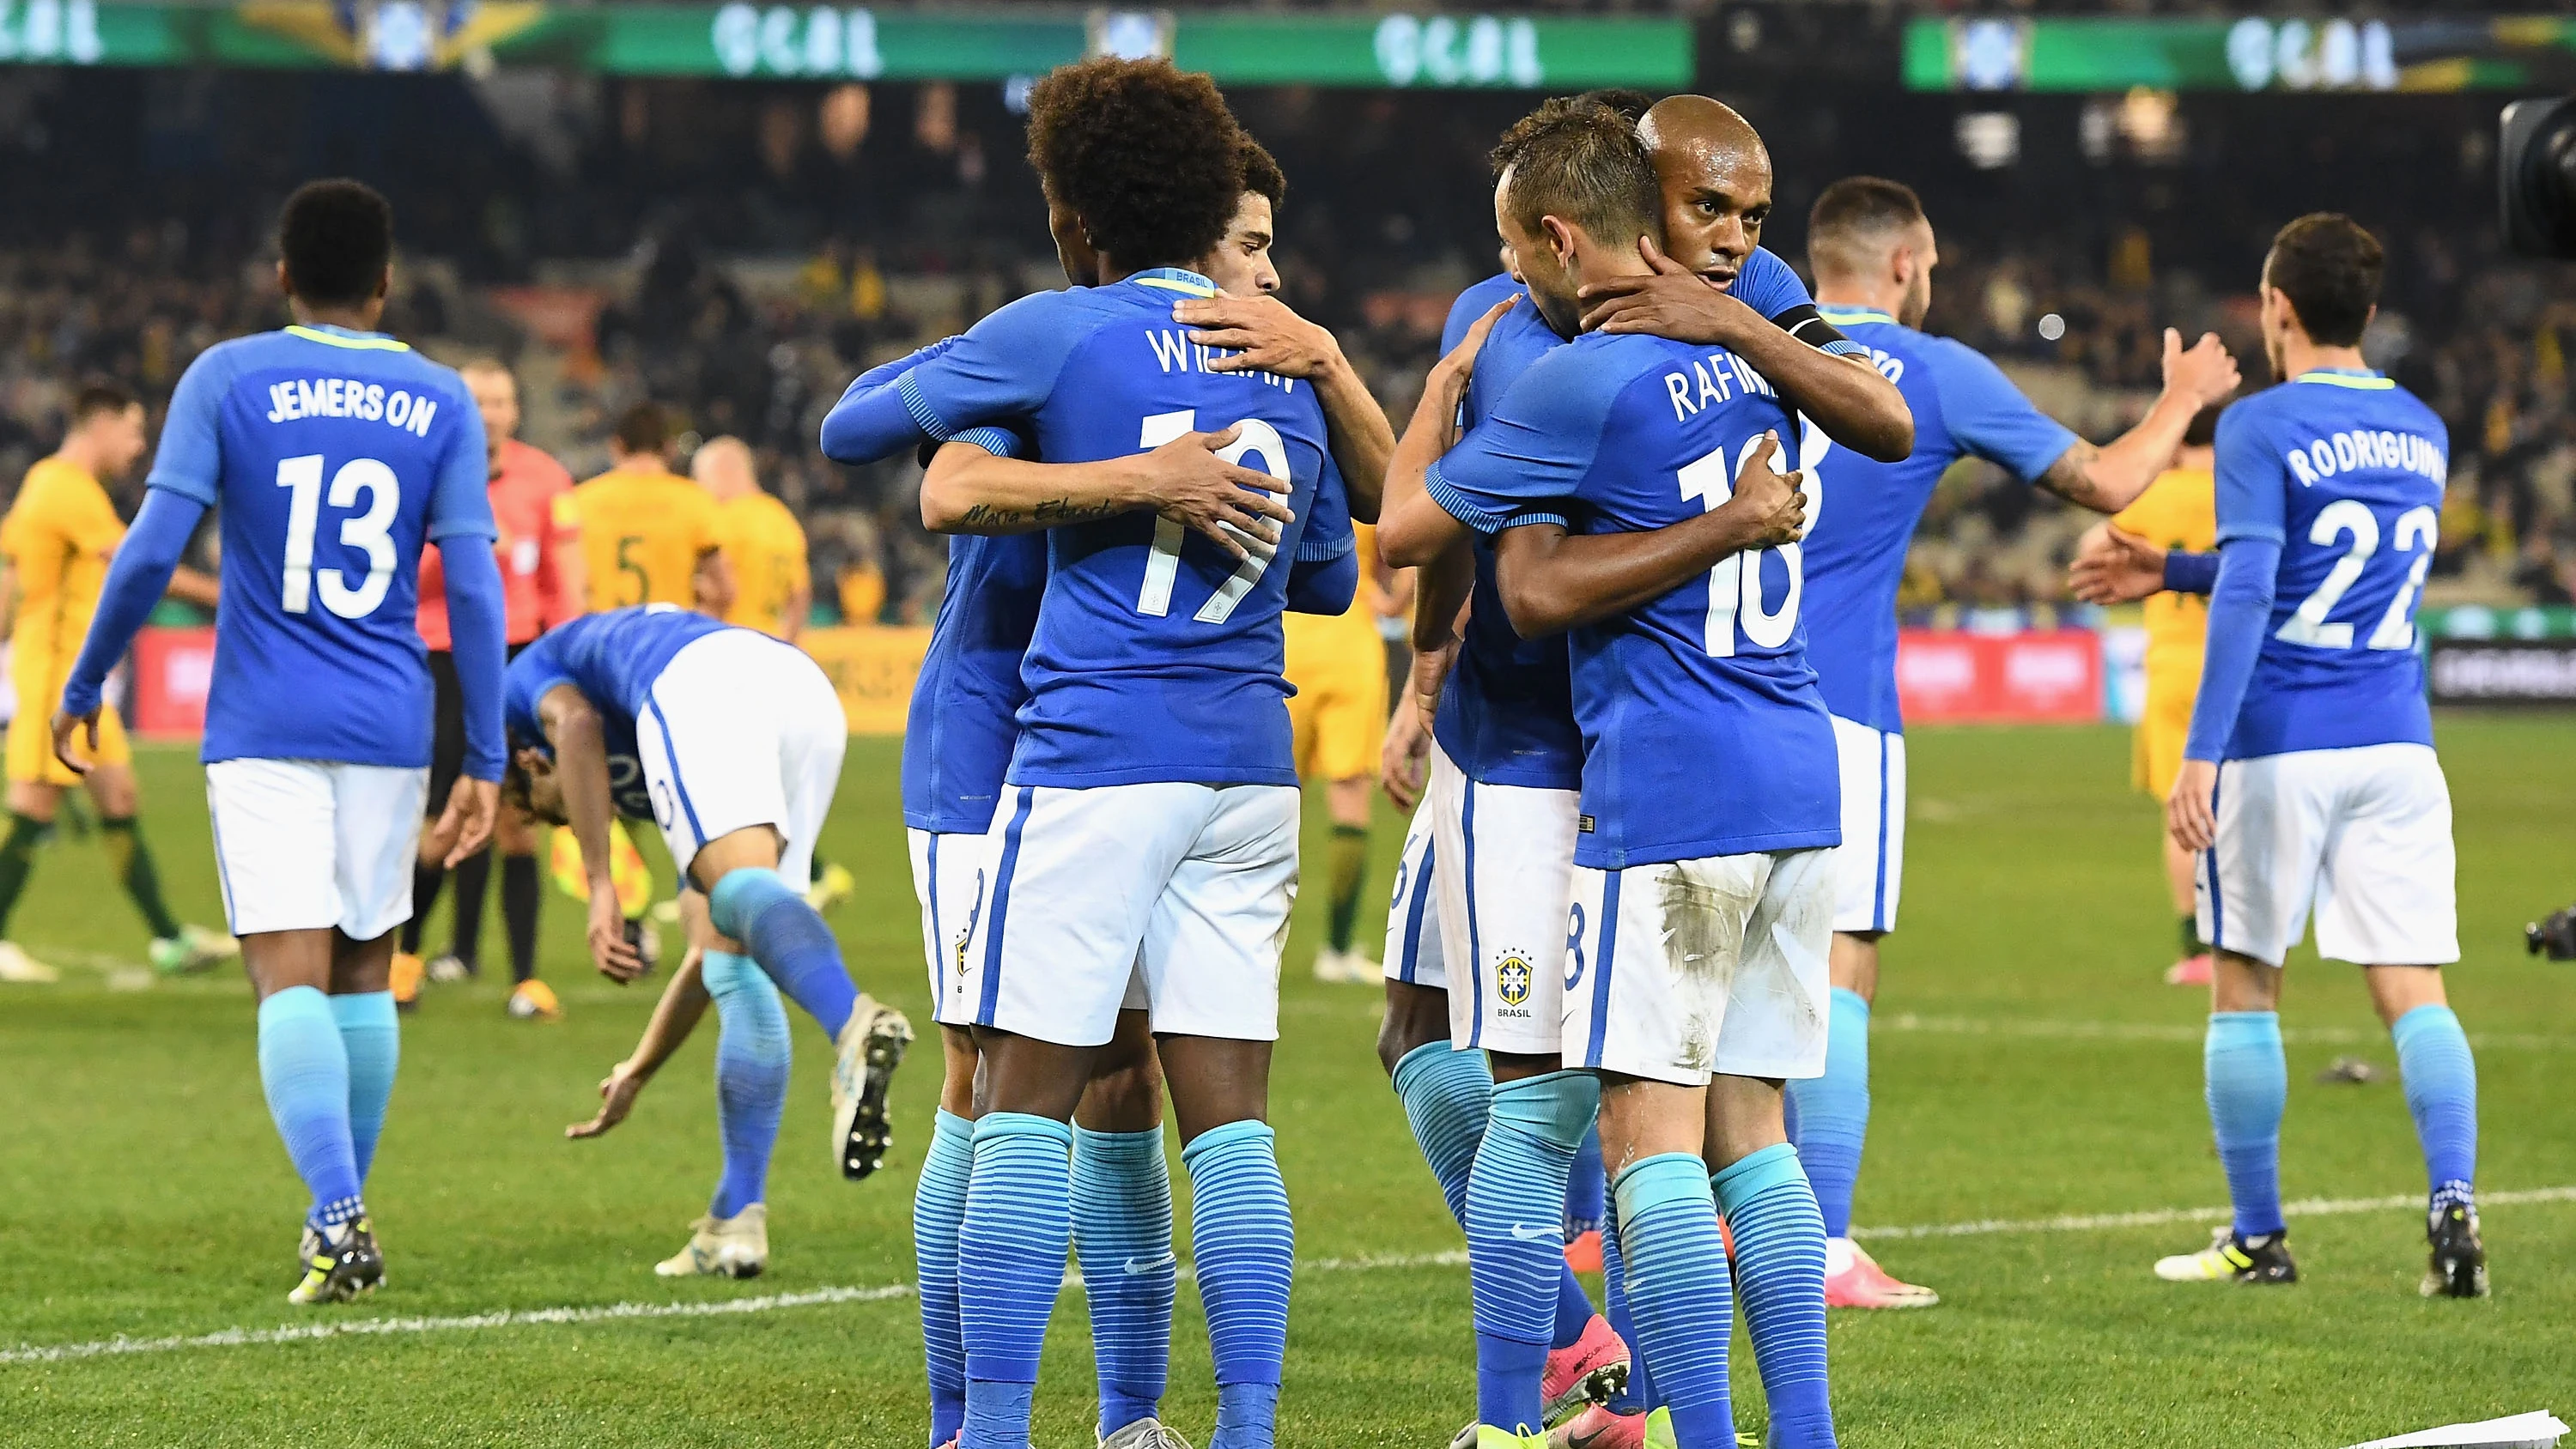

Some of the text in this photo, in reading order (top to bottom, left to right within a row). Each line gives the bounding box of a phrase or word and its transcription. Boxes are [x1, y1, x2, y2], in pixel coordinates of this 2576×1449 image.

[1176, 271, 1207, 288] BRASIL
[267, 379, 437, 437] JEMERSON
[1664, 352, 1779, 422] RAFIN
[276, 454, 400, 619] 13
[617, 535, 651, 606] 5
[2275, 499, 2439, 651] 22
[1498, 1008, 1532, 1018] BRASIL
